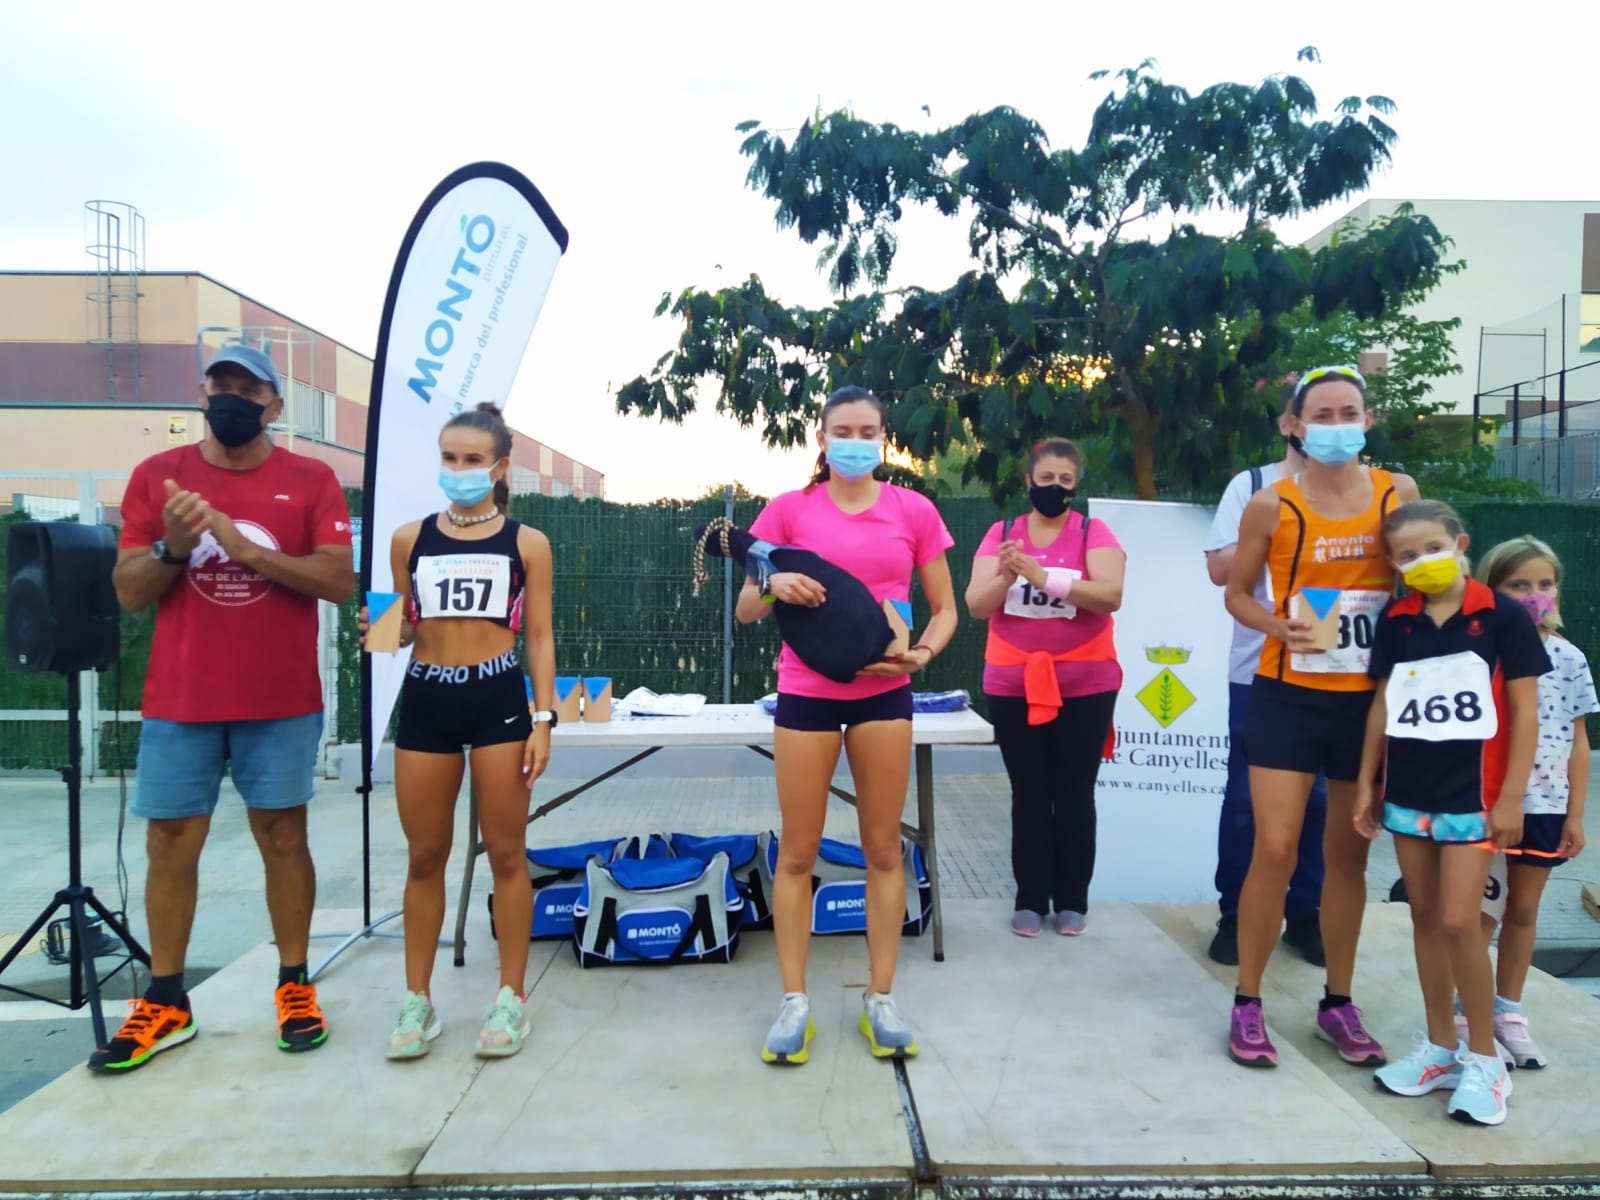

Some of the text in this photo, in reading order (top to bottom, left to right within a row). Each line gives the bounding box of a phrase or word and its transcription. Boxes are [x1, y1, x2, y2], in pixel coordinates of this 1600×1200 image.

[482, 224, 511, 283] pinturas
[407, 214, 496, 404] MONTÓ
[459, 352, 482, 399] marca
[476, 322, 493, 349] del
[488, 233, 529, 323] profesional
[434, 577, 493, 612] 157
[424, 662, 469, 684] PRO
[478, 649, 519, 680] NIKE
[1397, 690, 1483, 727] 468
[1114, 725, 1230, 749] juntament
[1101, 748, 1229, 774] e Canyelles
[1096, 779, 1227, 796] www.canyelles.ca
[555, 904, 574, 914] MO
[837, 898, 866, 909] MONT
[638, 922, 682, 938] MONTÓ
